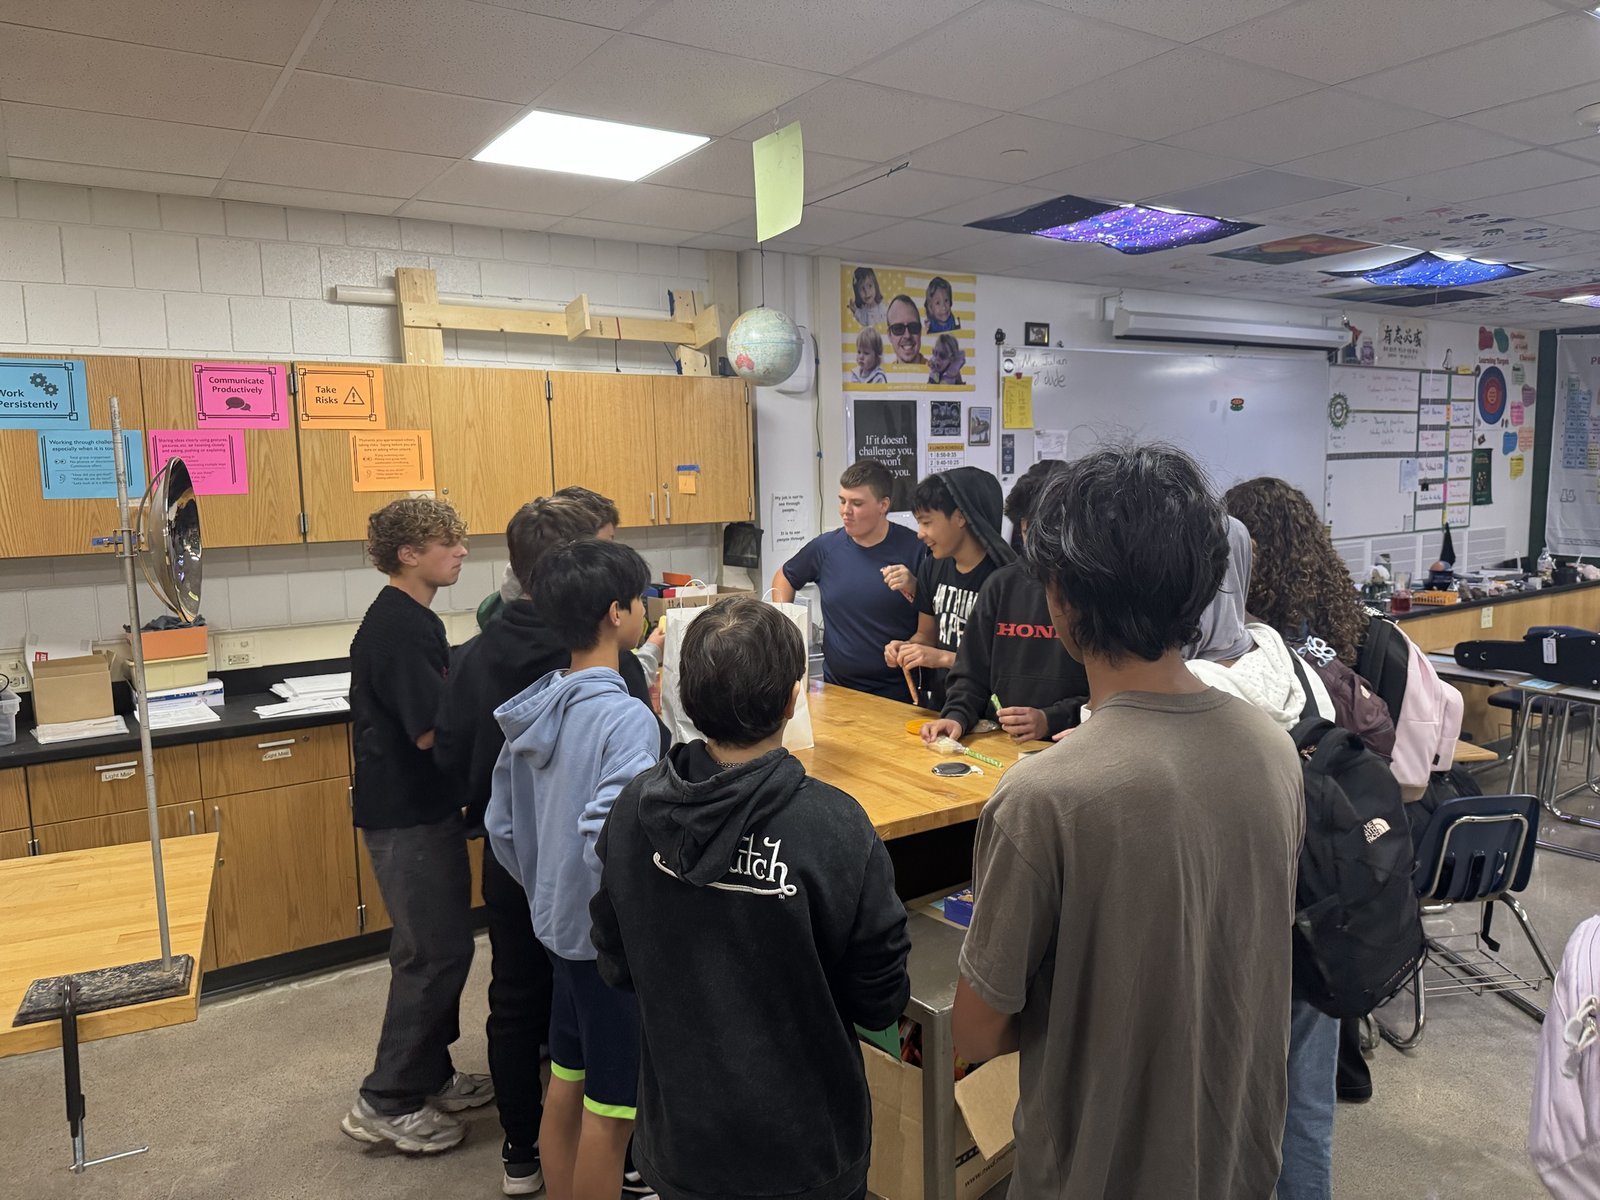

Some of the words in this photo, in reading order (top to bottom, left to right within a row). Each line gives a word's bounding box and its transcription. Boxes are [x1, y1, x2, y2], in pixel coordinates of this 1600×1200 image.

[209, 376, 265, 385] Communicate
[212, 385, 263, 395] Productively
[315, 385, 337, 394] Take
[316, 396, 338, 404] Risks
[865, 435, 874, 445] If
[874, 435, 880, 444] it
[881, 434, 908, 444] doesn't
[859, 446, 896, 458] challenge
[896, 448, 914, 460] you,
[894, 470, 911, 479] you.
[996, 622, 1060, 639] HON
[729, 833, 797, 896] utch
